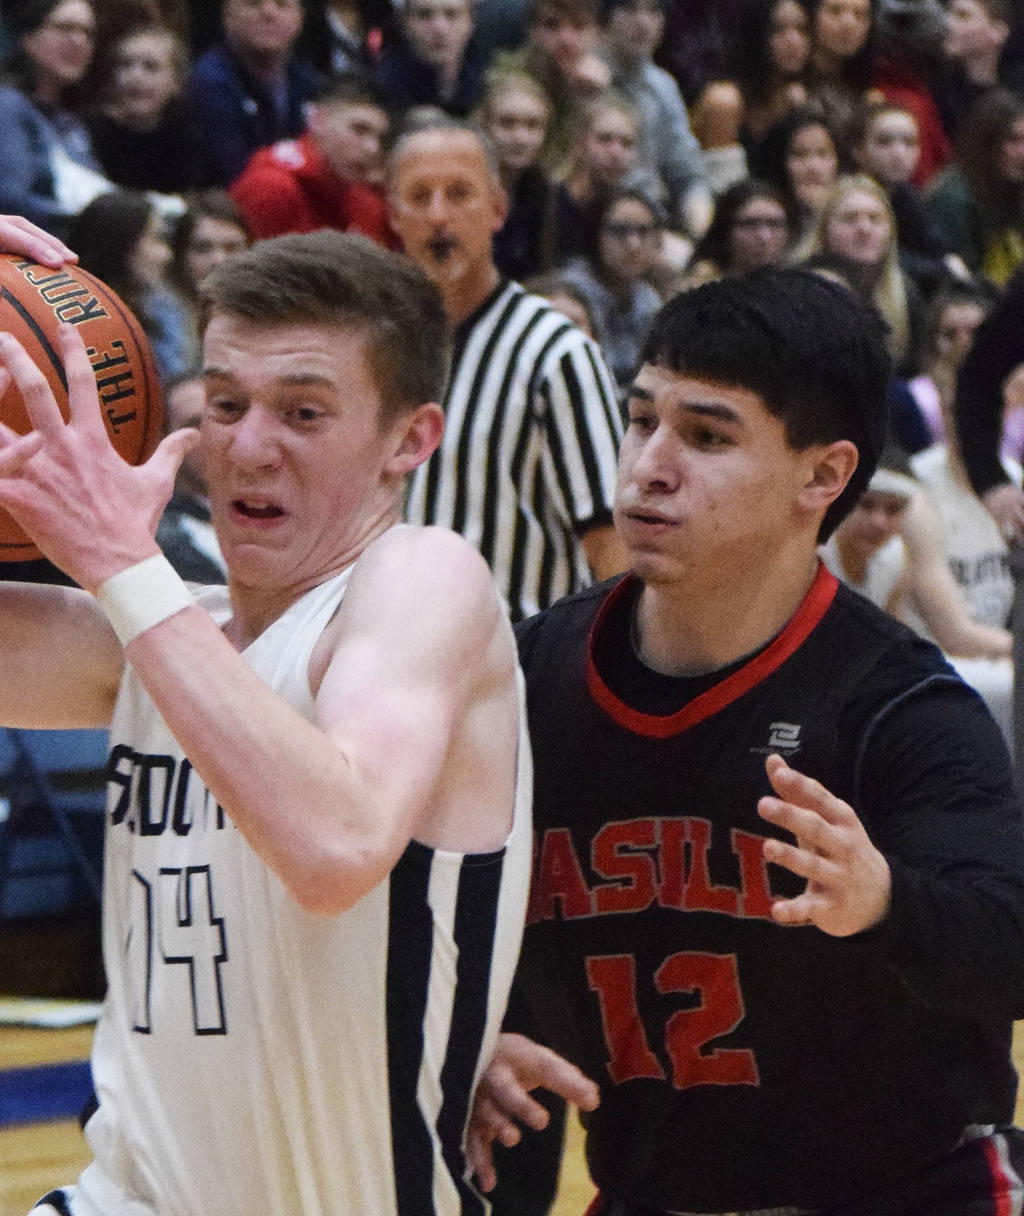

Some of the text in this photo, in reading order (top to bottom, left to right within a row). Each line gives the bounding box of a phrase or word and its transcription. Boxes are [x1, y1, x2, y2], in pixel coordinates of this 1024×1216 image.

[86, 340, 137, 434] THE
[129, 864, 228, 1036] 14
[584, 950, 760, 1090] 12
